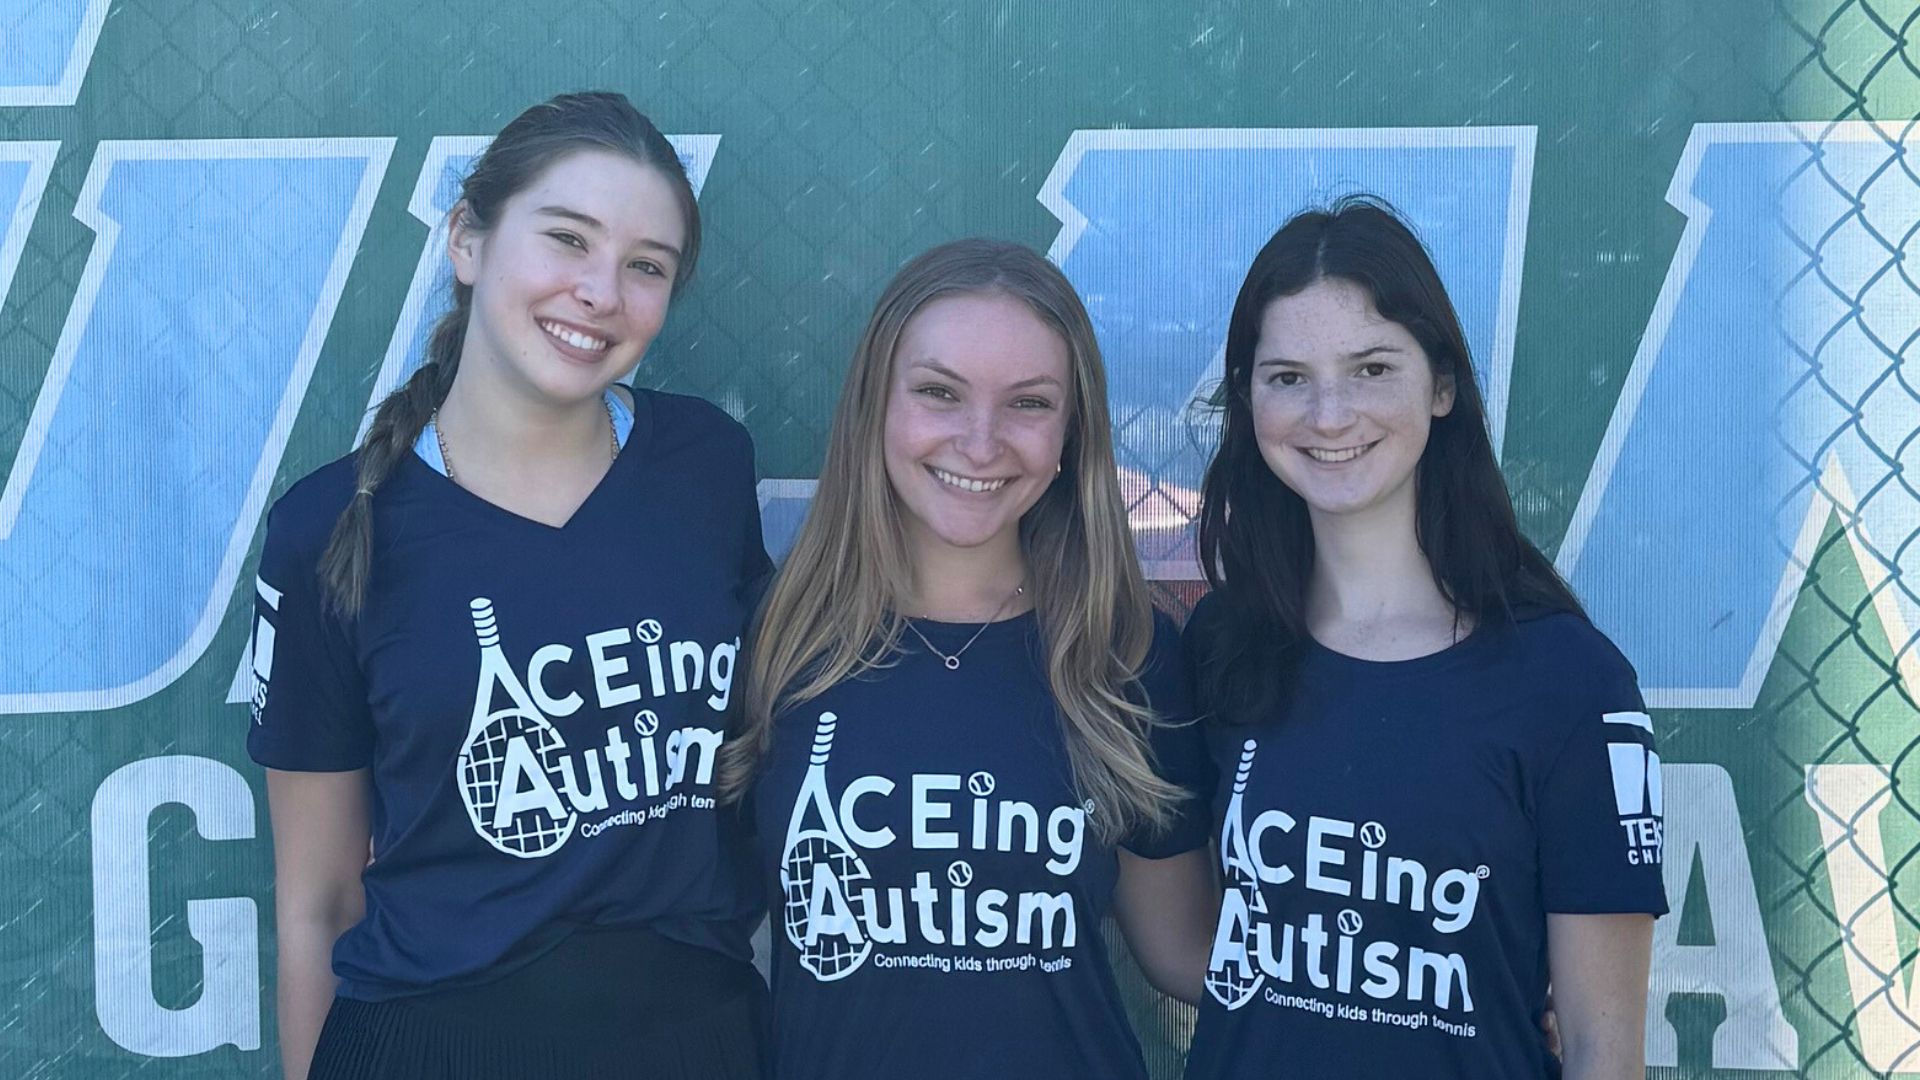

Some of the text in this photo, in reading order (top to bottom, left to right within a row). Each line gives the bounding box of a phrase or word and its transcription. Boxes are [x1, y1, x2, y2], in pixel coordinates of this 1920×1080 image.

[804, 860, 1077, 950] Autism
[874, 953, 951, 973] Connecting
[954, 956, 983, 972] kids
[985, 954, 1036, 972] through
[1208, 888, 1475, 1013] Autism
[1264, 986, 1477, 1038] Connecting kids through tennis
